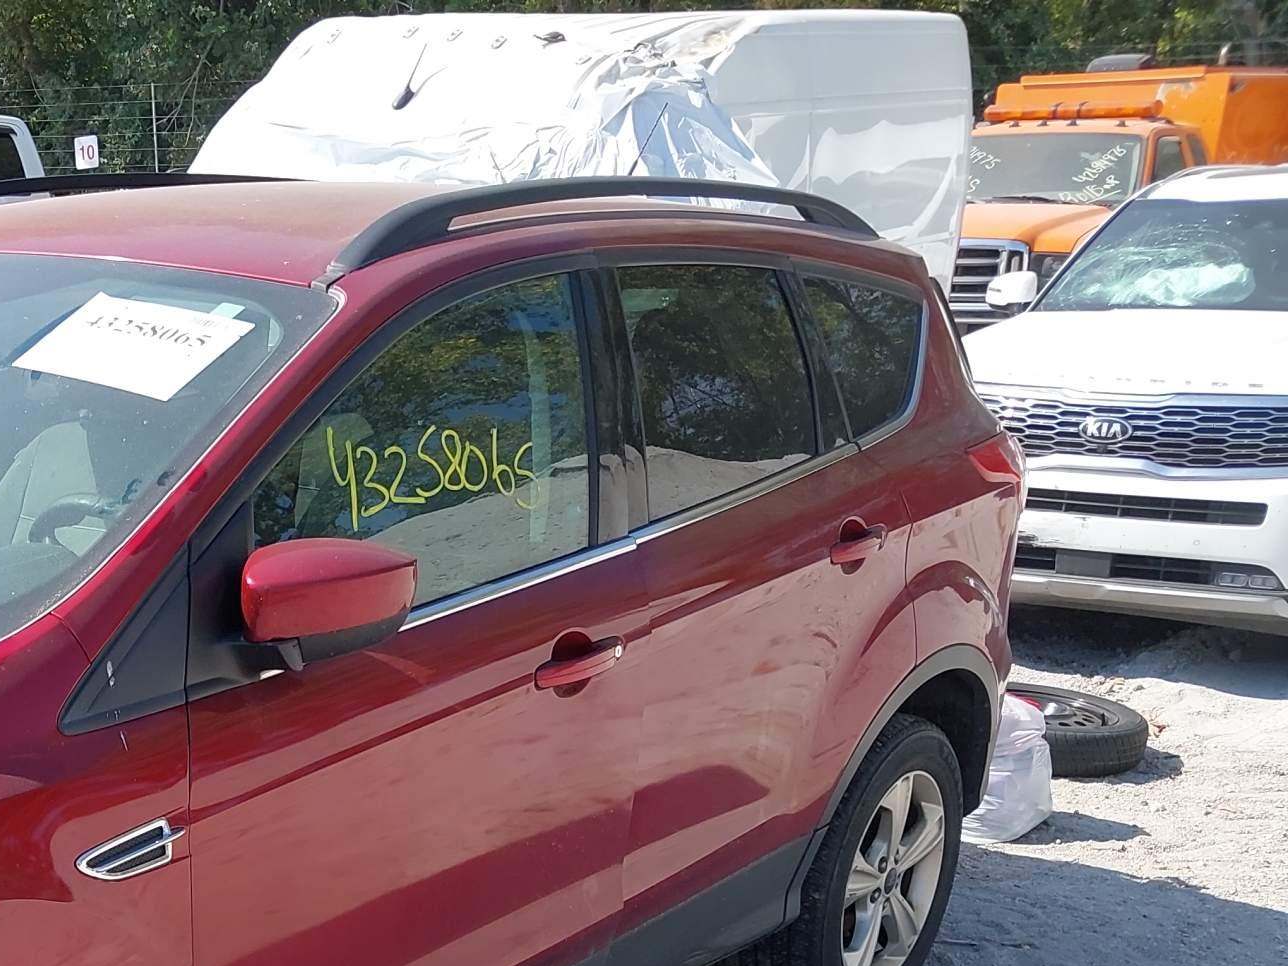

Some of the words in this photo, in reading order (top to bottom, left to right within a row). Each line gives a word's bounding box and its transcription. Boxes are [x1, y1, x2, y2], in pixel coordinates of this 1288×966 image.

[79, 144, 95, 161] 10
[86, 315, 212, 347] 43258065
[1086, 420, 1122, 438] KIA
[326, 424, 541, 531] 43258065
